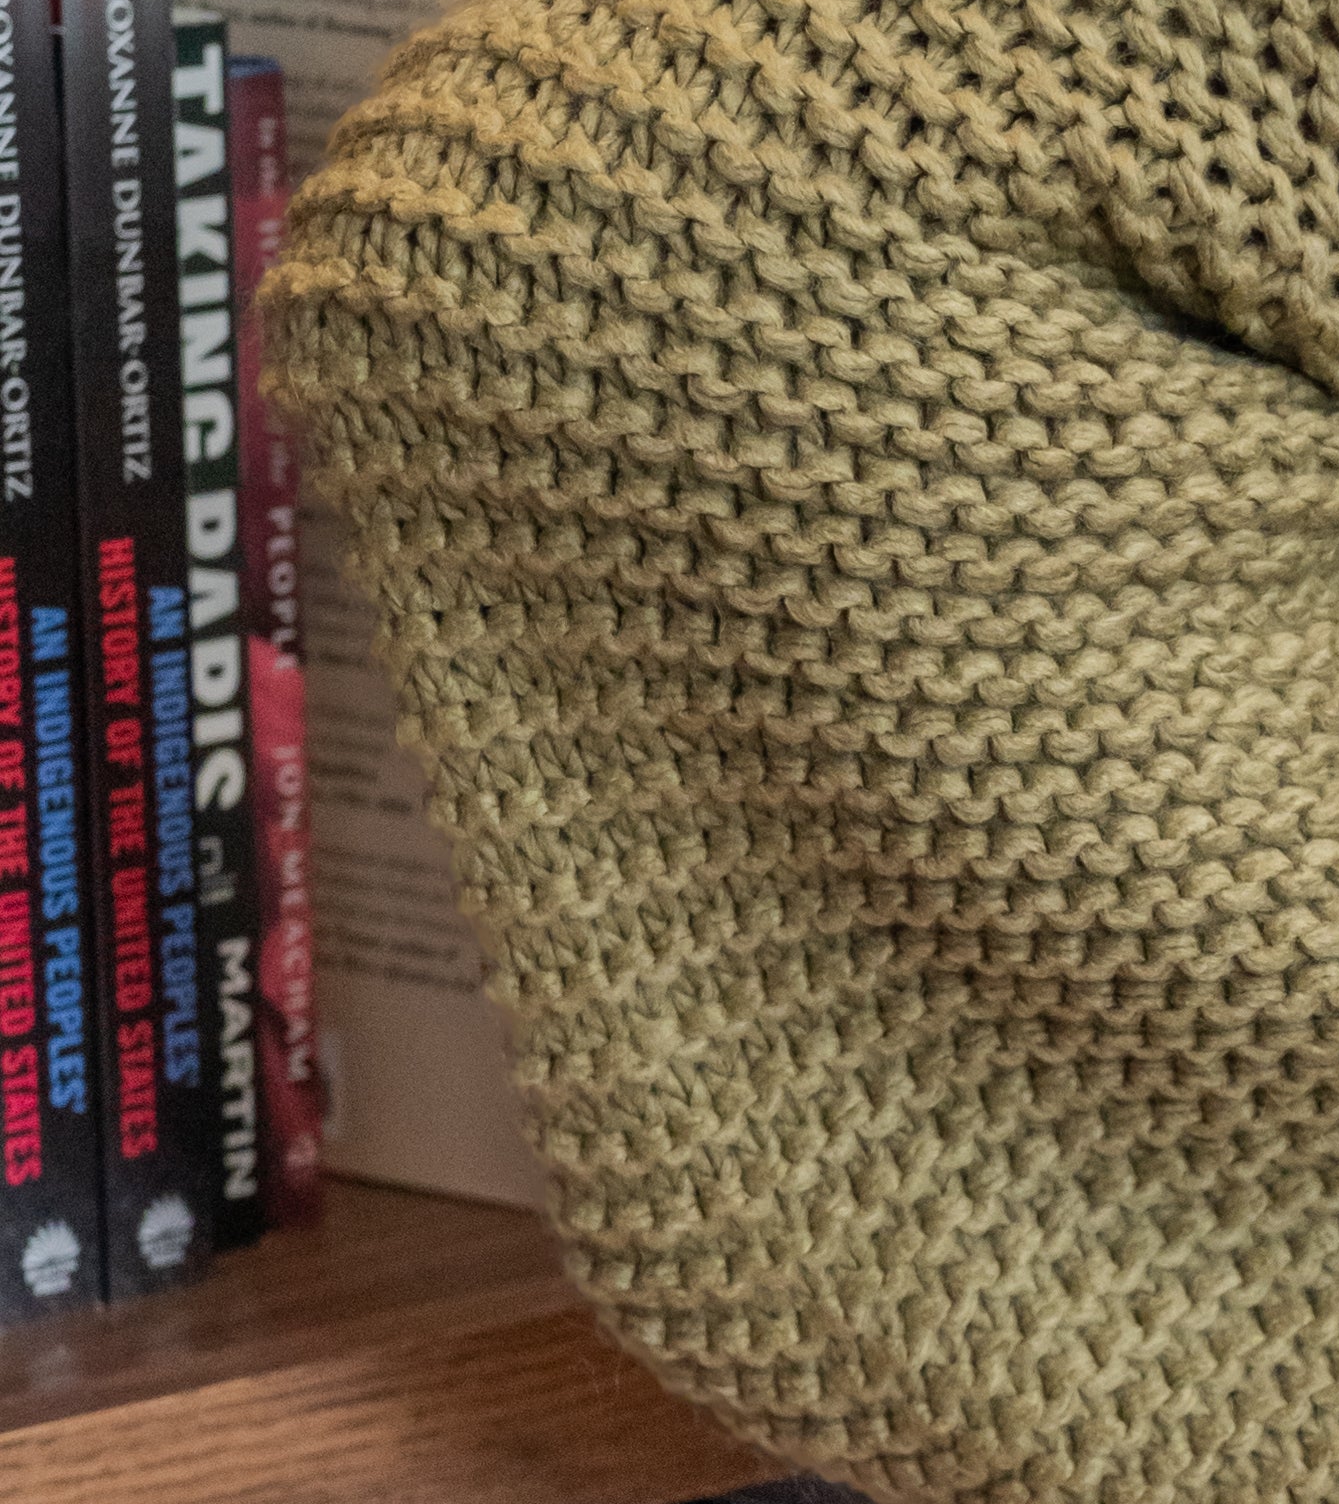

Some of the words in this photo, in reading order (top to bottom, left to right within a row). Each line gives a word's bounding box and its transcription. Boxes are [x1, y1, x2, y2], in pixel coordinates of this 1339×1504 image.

[172, 43, 235, 463] TAKING
[112, 180, 152, 484] DUNBAR-ORTIZ
[31, 607, 68, 662] AN
[100, 537, 140, 705] HISTORY
[149, 586, 184, 641] AN
[33, 670, 78, 921] INDIGENOUS
[106, 717, 143, 770] OF
[150, 650, 194, 896] INDIGENOUS
[109, 781, 147, 857] THE
[0, 890, 36, 1037] UNITED
[111, 866, 152, 1012] UNITED
[2, 1043, 42, 1187] STATES
[117, 1020, 158, 1160] STATES
[217, 936, 258, 1199] MARTIN
